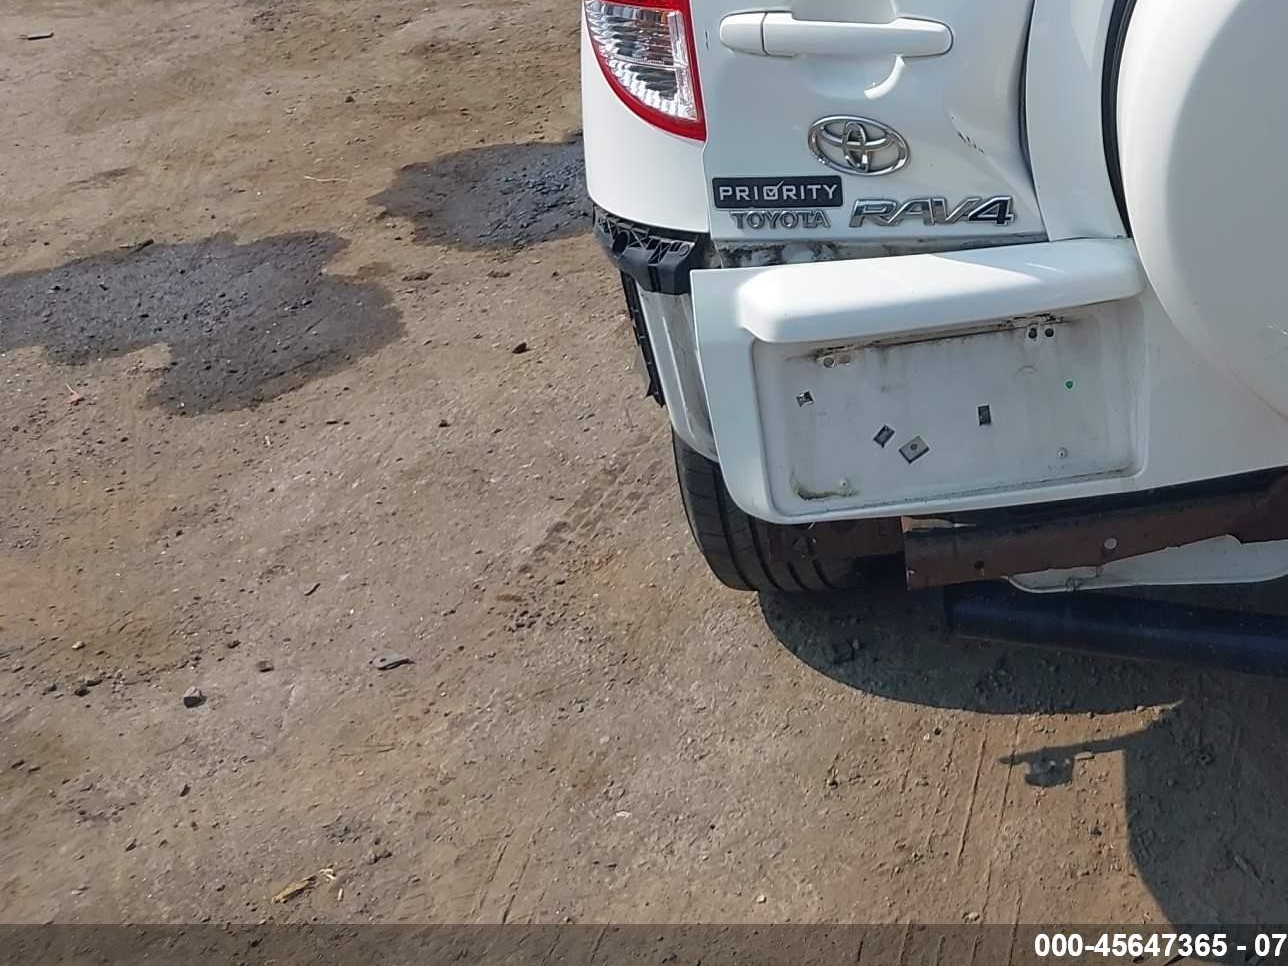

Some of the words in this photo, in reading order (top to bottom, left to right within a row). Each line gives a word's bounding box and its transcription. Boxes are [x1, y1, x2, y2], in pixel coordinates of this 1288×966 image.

[719, 181, 839, 200] PRIORITY
[731, 211, 831, 230] TOYOTA
[849, 196, 1015, 228] RAV4
